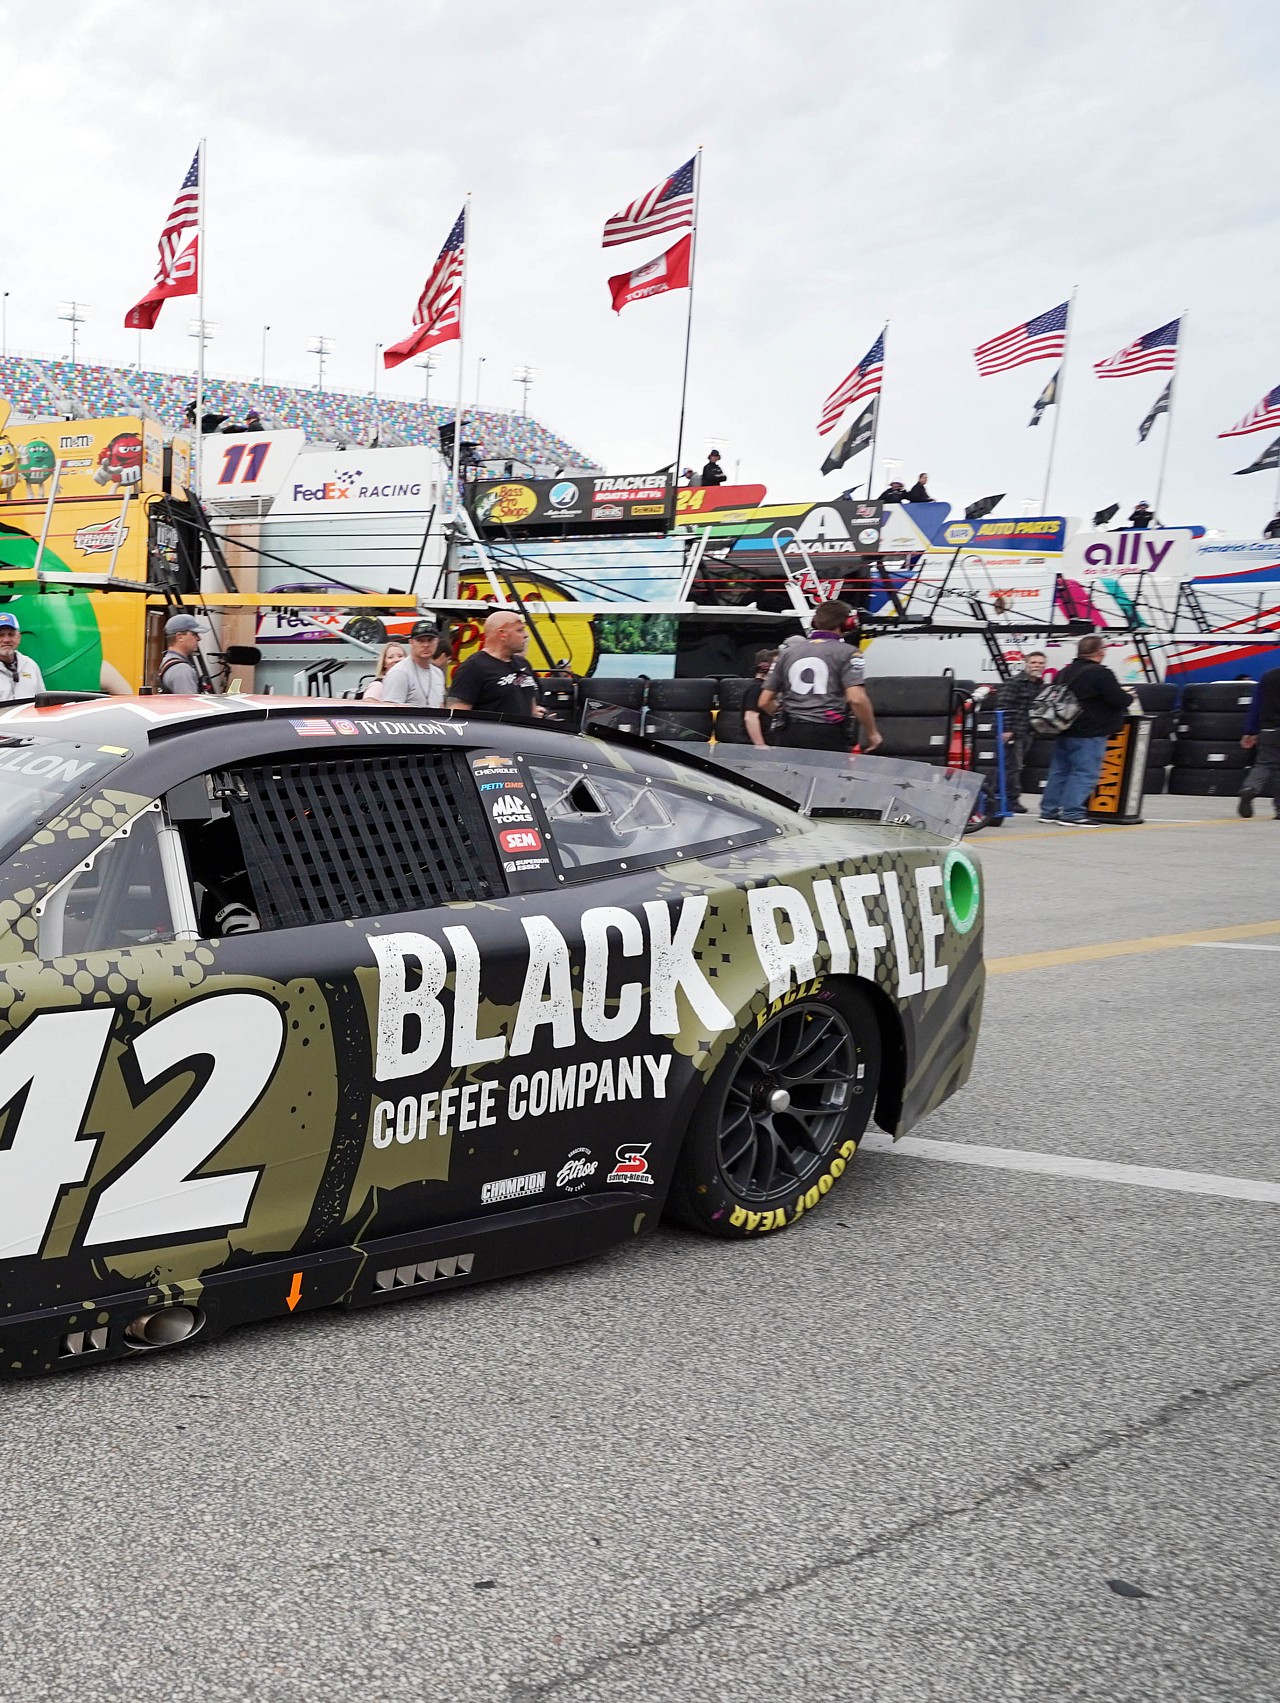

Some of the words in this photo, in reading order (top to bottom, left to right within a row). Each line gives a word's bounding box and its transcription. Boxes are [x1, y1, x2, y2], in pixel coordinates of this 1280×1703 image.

[625, 282, 669, 300] TOYOTA
[217, 442, 273, 485] 11
[293, 482, 350, 502] FedEx
[358, 483, 421, 498] RACING
[499, 486, 524, 498] Bass
[593, 475, 668, 492] TRACKER
[595, 492, 630, 501] BOATS
[677, 490, 707, 511] 24
[499, 505, 530, 518] Shops
[976, 522, 1015, 536] AUTO
[1014, 520, 1062, 534] PARTS
[783, 540, 857, 555] AXALTA
[1084, 533, 1176, 573] ally
[788, 656, 829, 695] a
[474, 768, 519, 777] CHEVROLET
[1094, 731, 1132, 811] DEWAL
[492, 794, 532, 818] MAC
[493, 814, 534, 824] TOOLS
[505, 832, 537, 850] SEM
[515, 857, 550, 865] SUPERIOR
[516, 863, 542, 871] ESSEX
[367, 895, 735, 1082] BLACK
[747, 865, 951, 1003] RIFLE
[757, 977, 825, 1031] EAGLE
[372, 1078, 504, 1149] COFFEE
[508, 1054, 673, 1122] COMPANY
[556, 1157, 599, 1188] Ethos
[481, 1171, 547, 1201] CHAMPION
